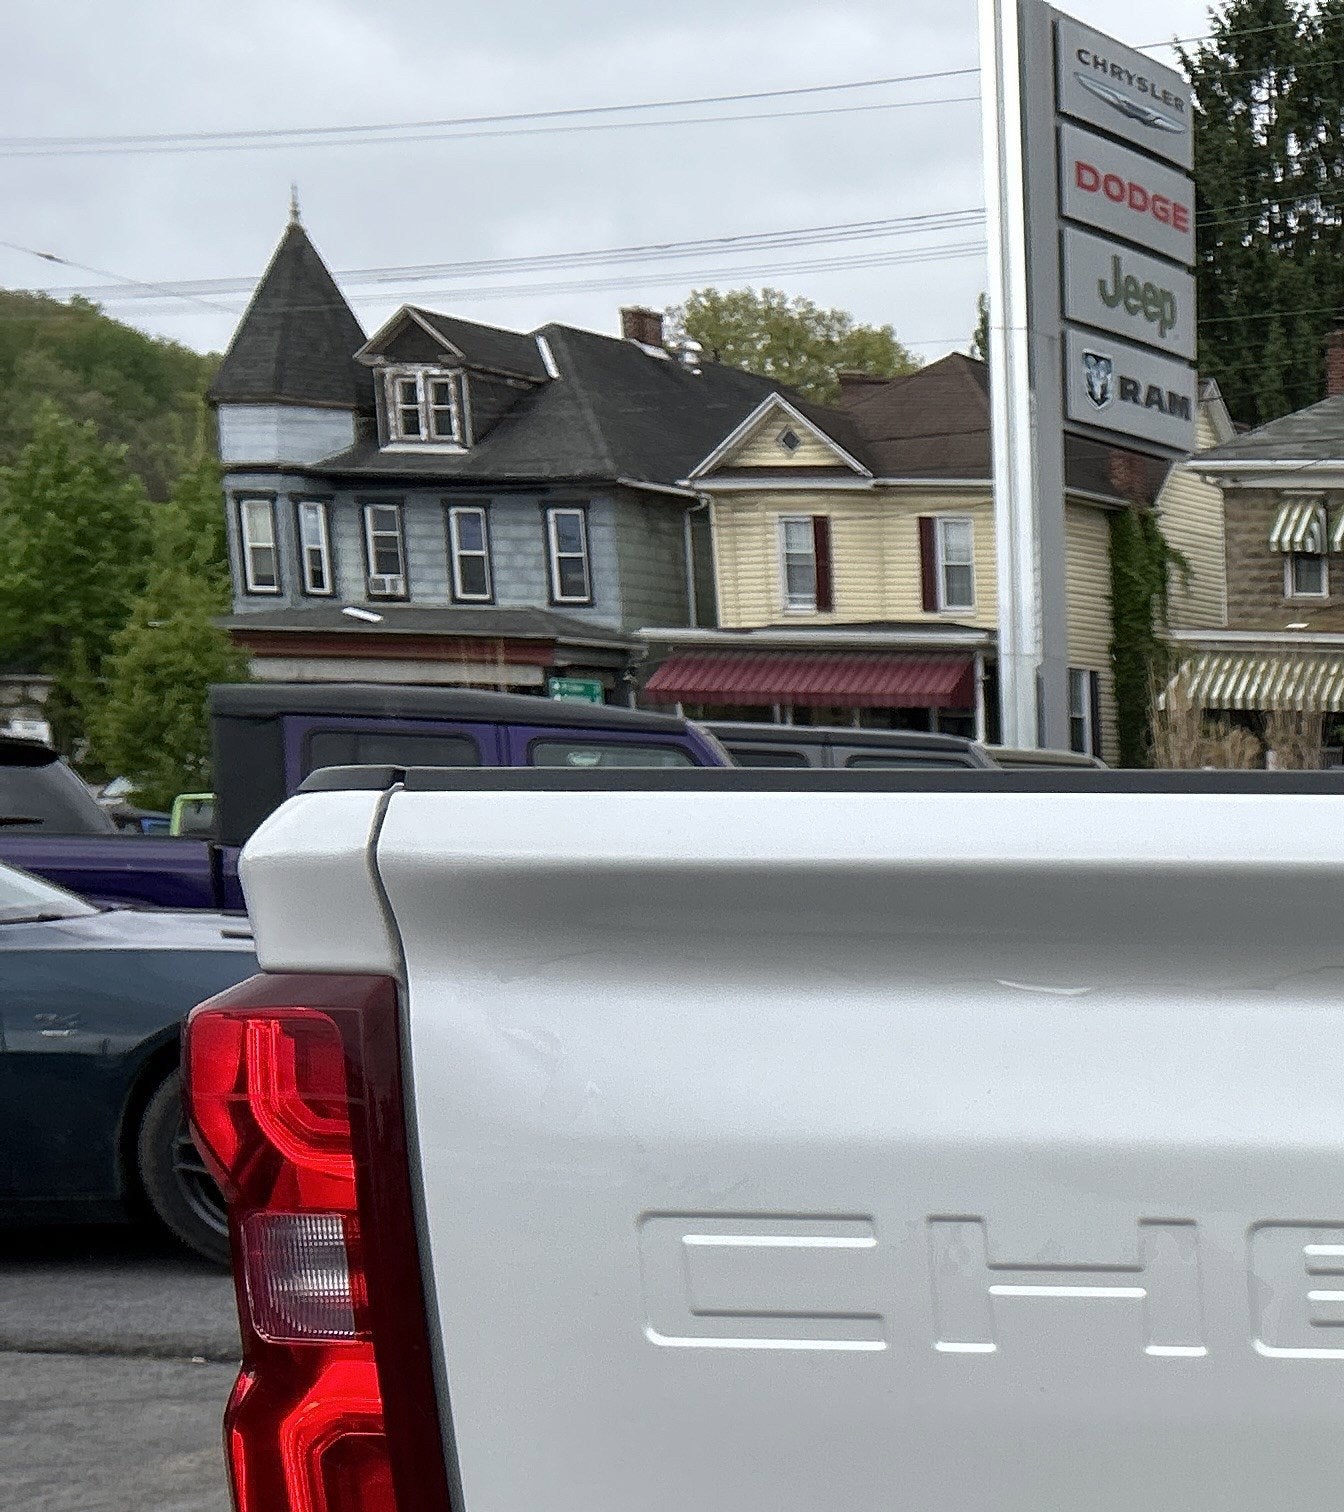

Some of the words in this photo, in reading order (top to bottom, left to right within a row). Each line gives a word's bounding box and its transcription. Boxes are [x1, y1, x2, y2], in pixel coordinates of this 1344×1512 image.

[1076, 48, 1186, 114] CHRYSLER
[1075, 160, 1190, 234] DODGE
[1099, 254, 1178, 339] Jeep
[1119, 375, 1191, 421] RAM
